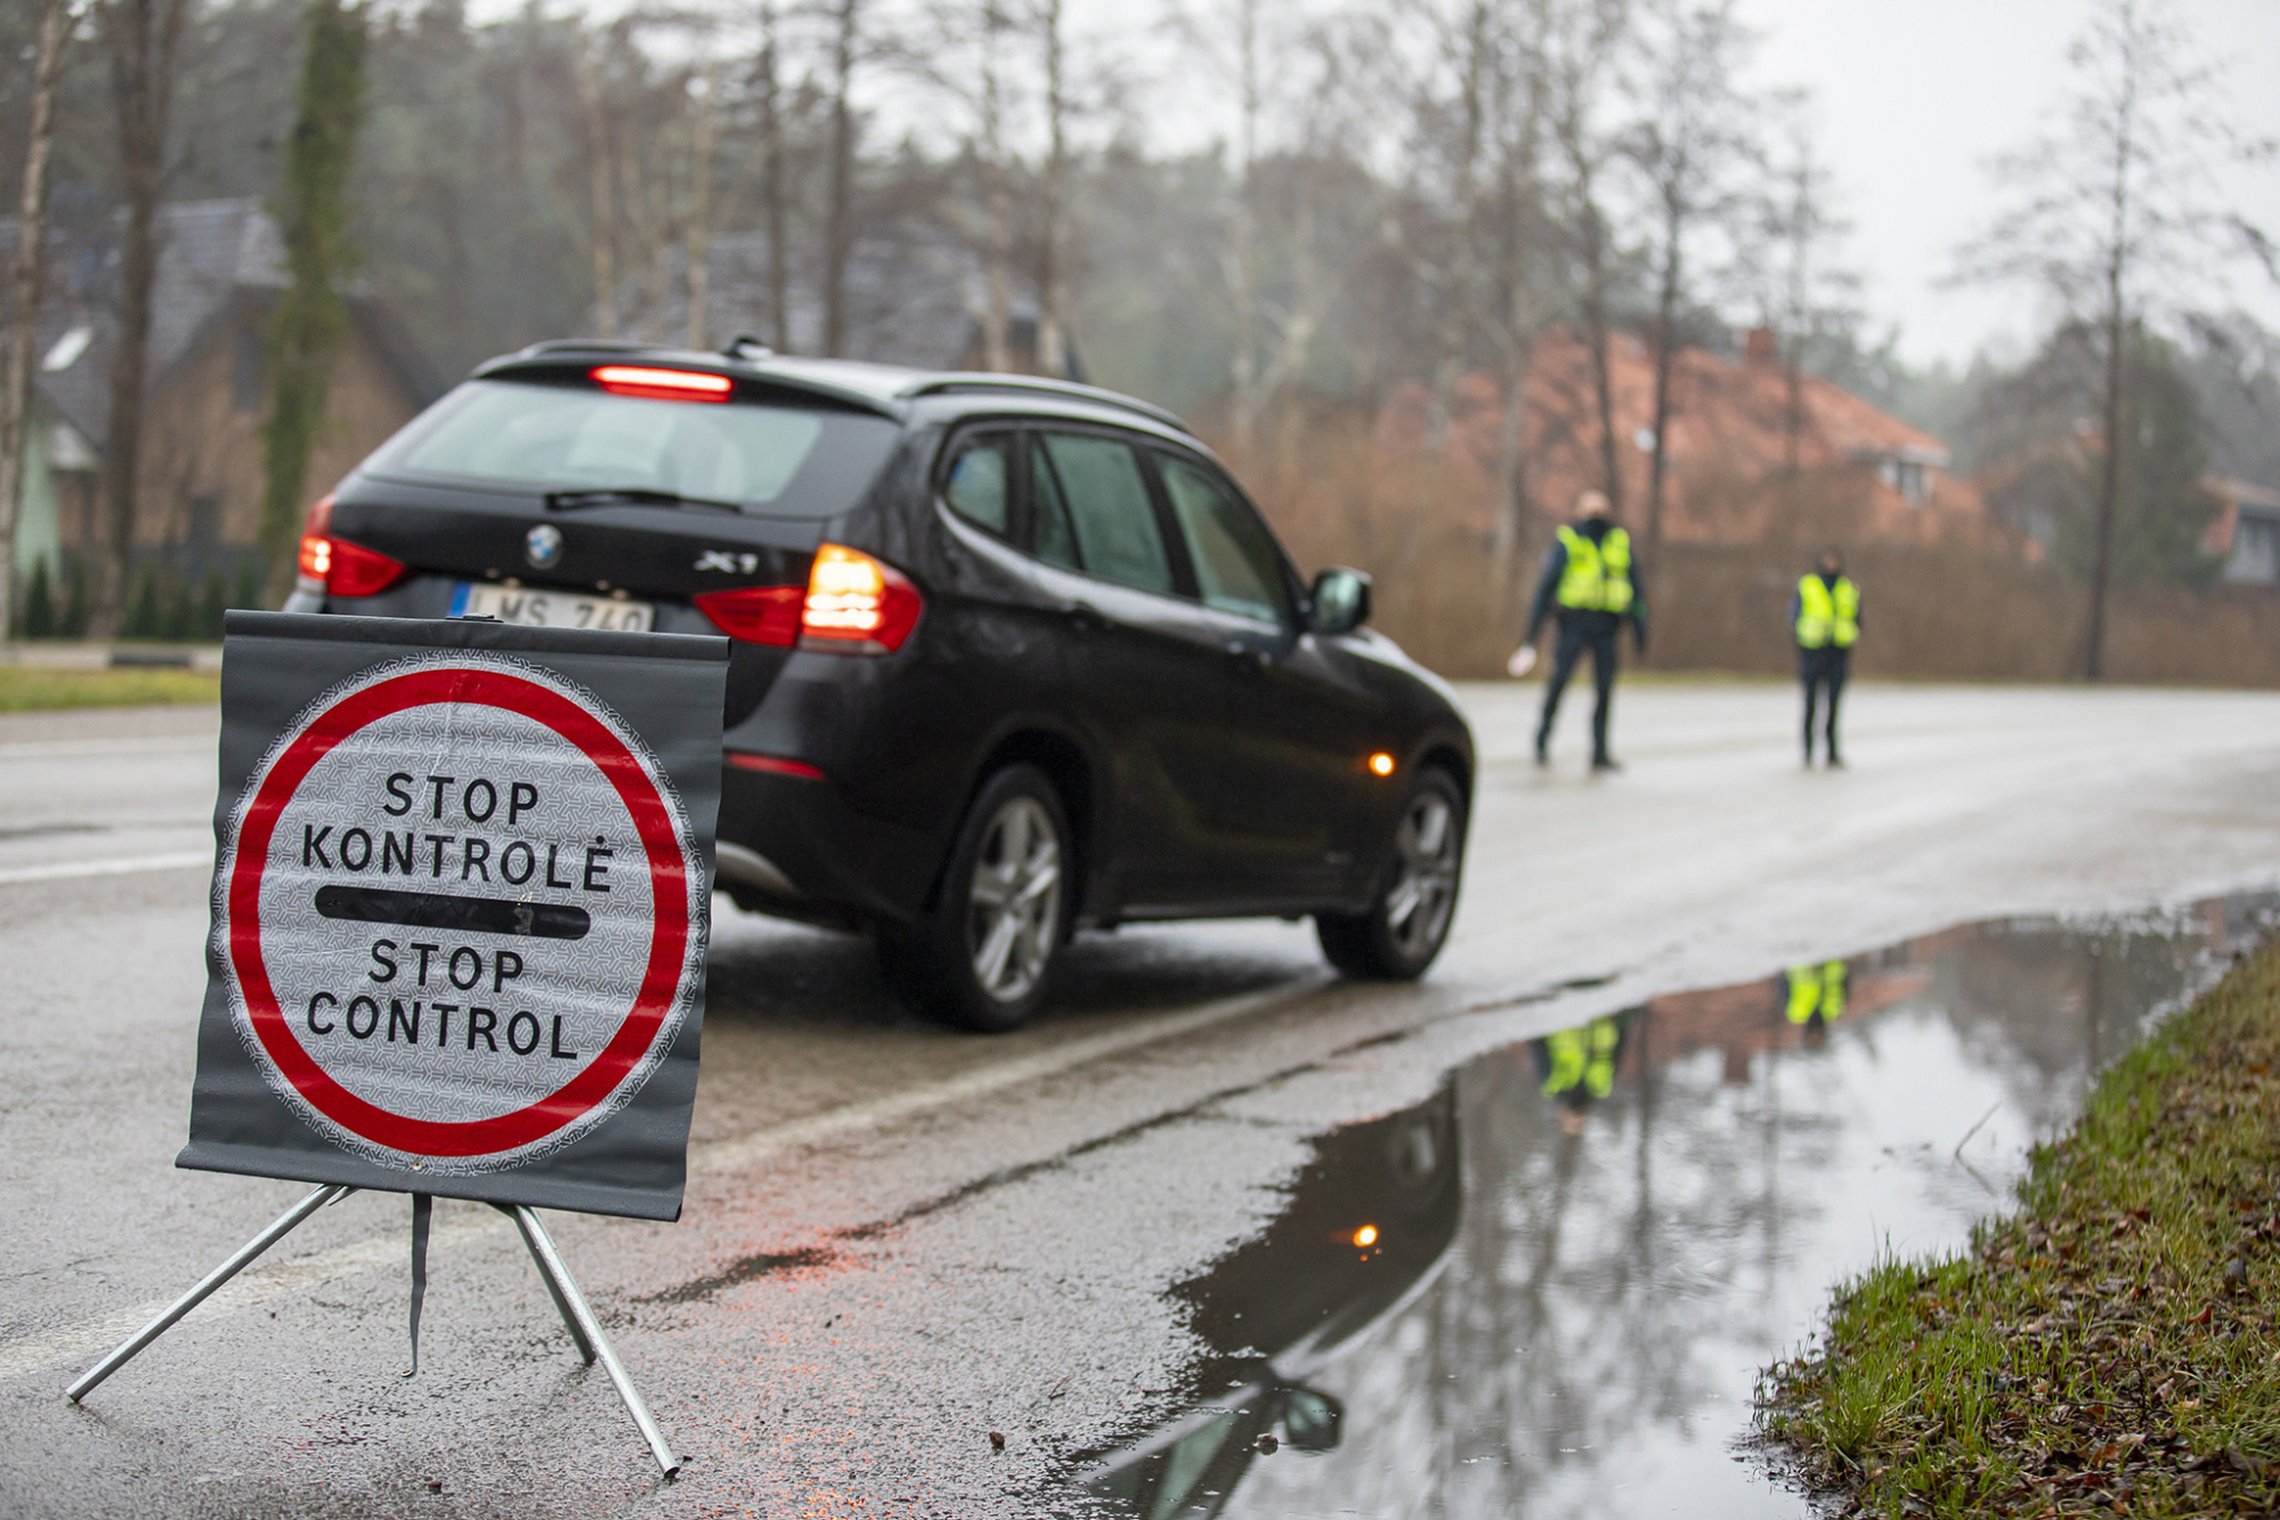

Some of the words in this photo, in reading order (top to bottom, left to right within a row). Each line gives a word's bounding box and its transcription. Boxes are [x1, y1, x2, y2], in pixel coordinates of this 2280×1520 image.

[693, 549, 759, 574] X1
[382, 772, 539, 825] STOP
[302, 824, 614, 893] KONTROLĖ
[367, 938, 524, 991] STOP
[307, 992, 578, 1060] CONTROL
